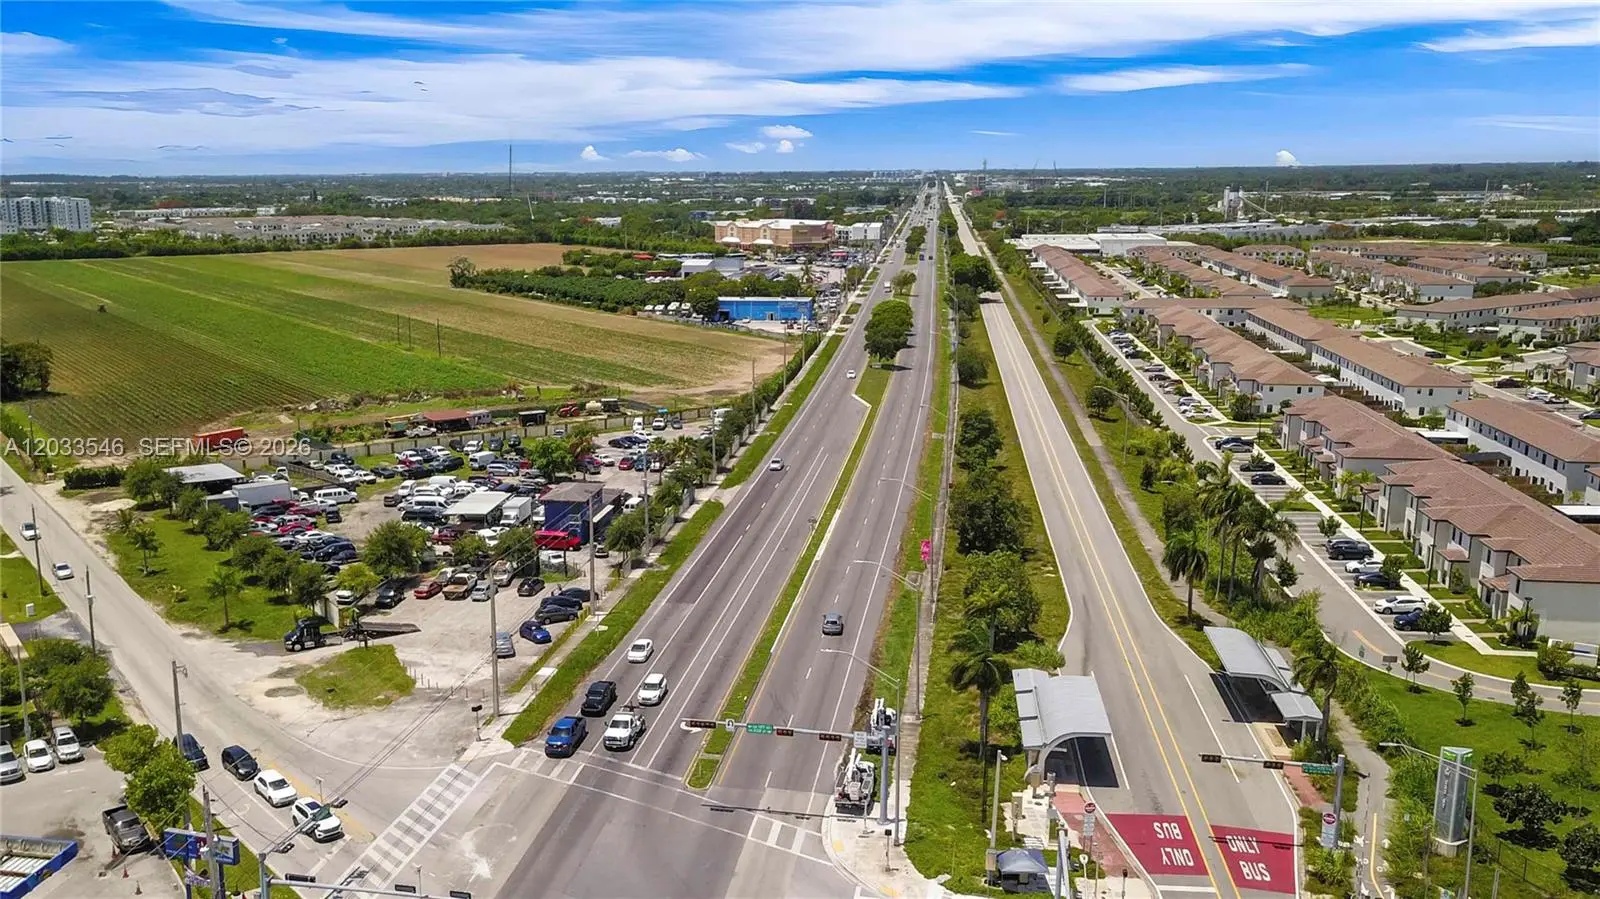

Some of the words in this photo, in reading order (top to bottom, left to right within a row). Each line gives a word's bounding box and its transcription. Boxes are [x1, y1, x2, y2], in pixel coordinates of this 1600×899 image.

[1153, 822, 1183, 840] BUS
[1225, 835, 1260, 854] ONLY
[1161, 847, 1195, 866] ONLY
[1239, 861, 1271, 881] BUS
